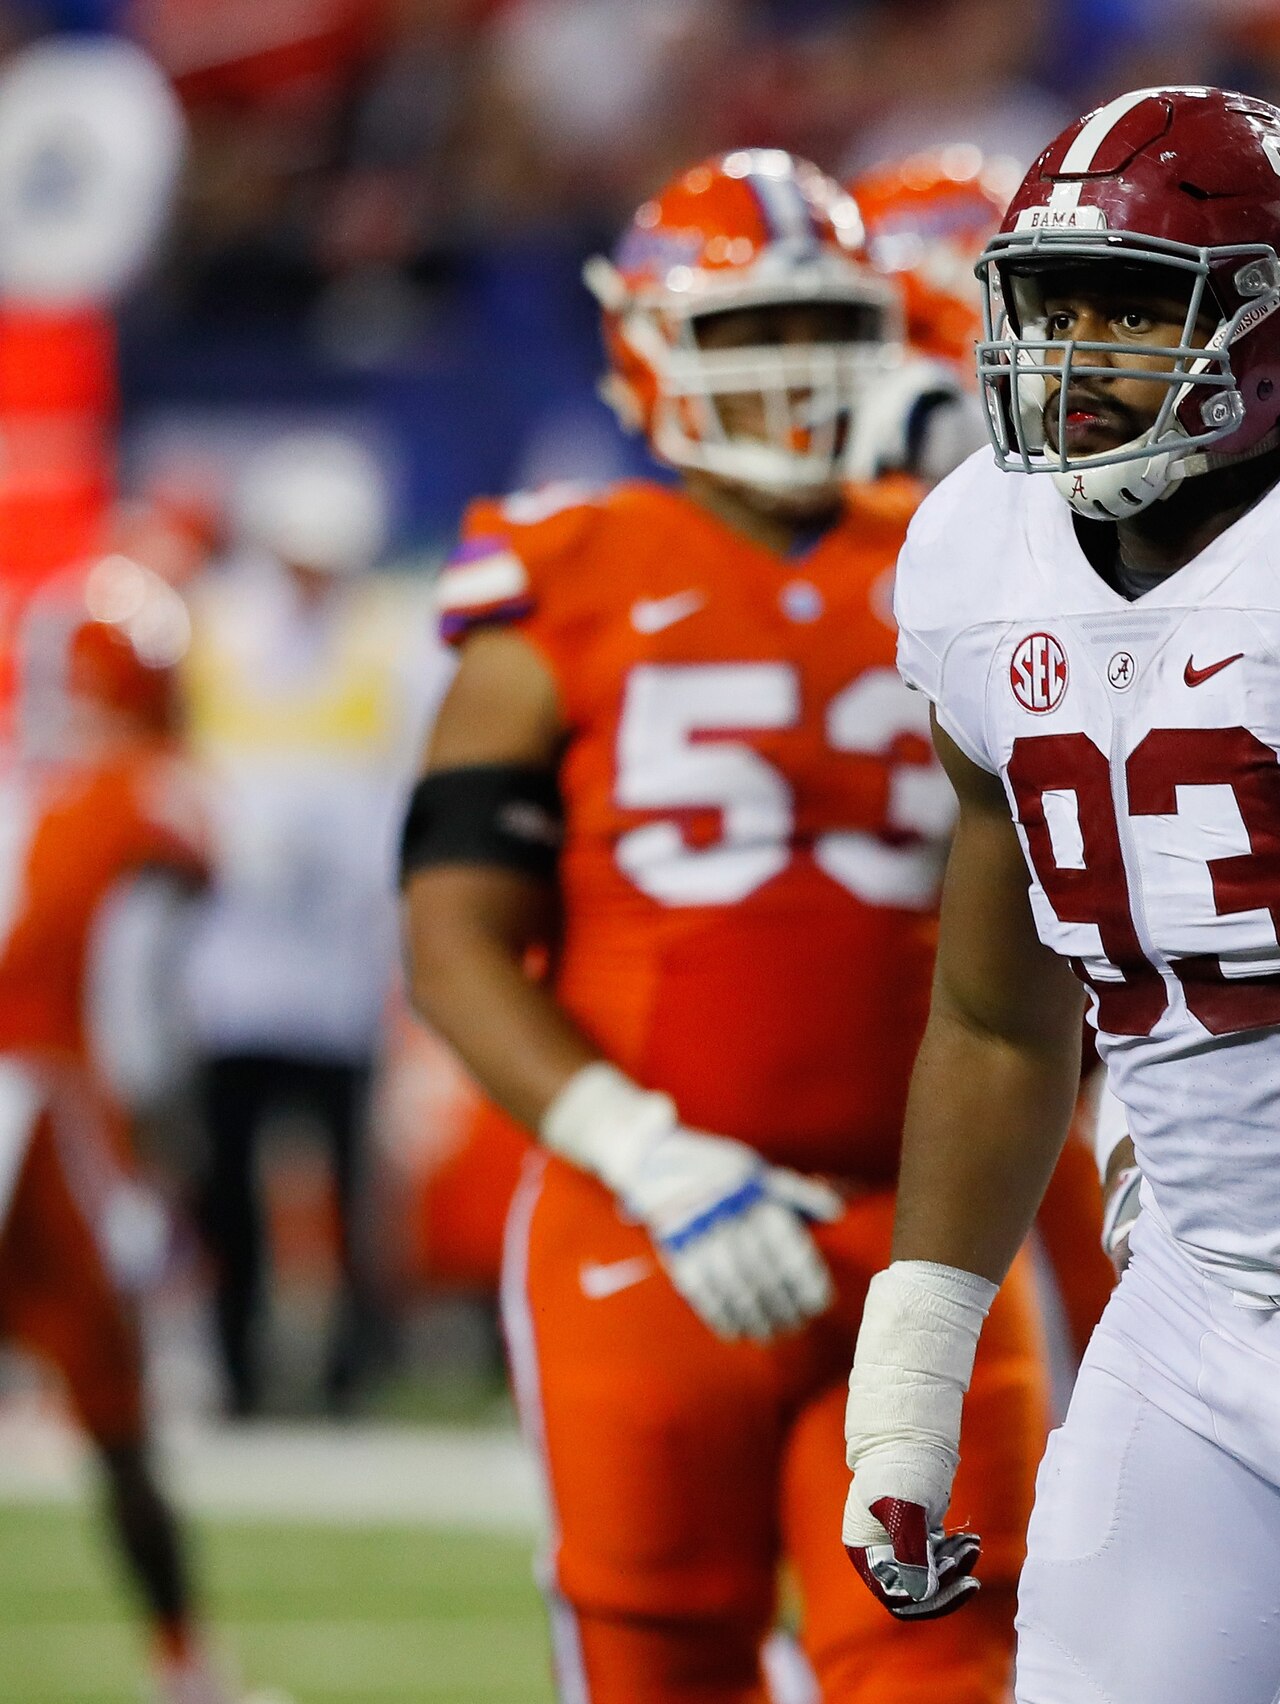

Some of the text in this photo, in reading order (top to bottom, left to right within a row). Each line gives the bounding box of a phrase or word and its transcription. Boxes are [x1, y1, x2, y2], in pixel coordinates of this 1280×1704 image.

[1031, 212, 1077, 228] BAMA
[1012, 635, 1065, 709] SEC
[615, 662, 957, 910] 53
